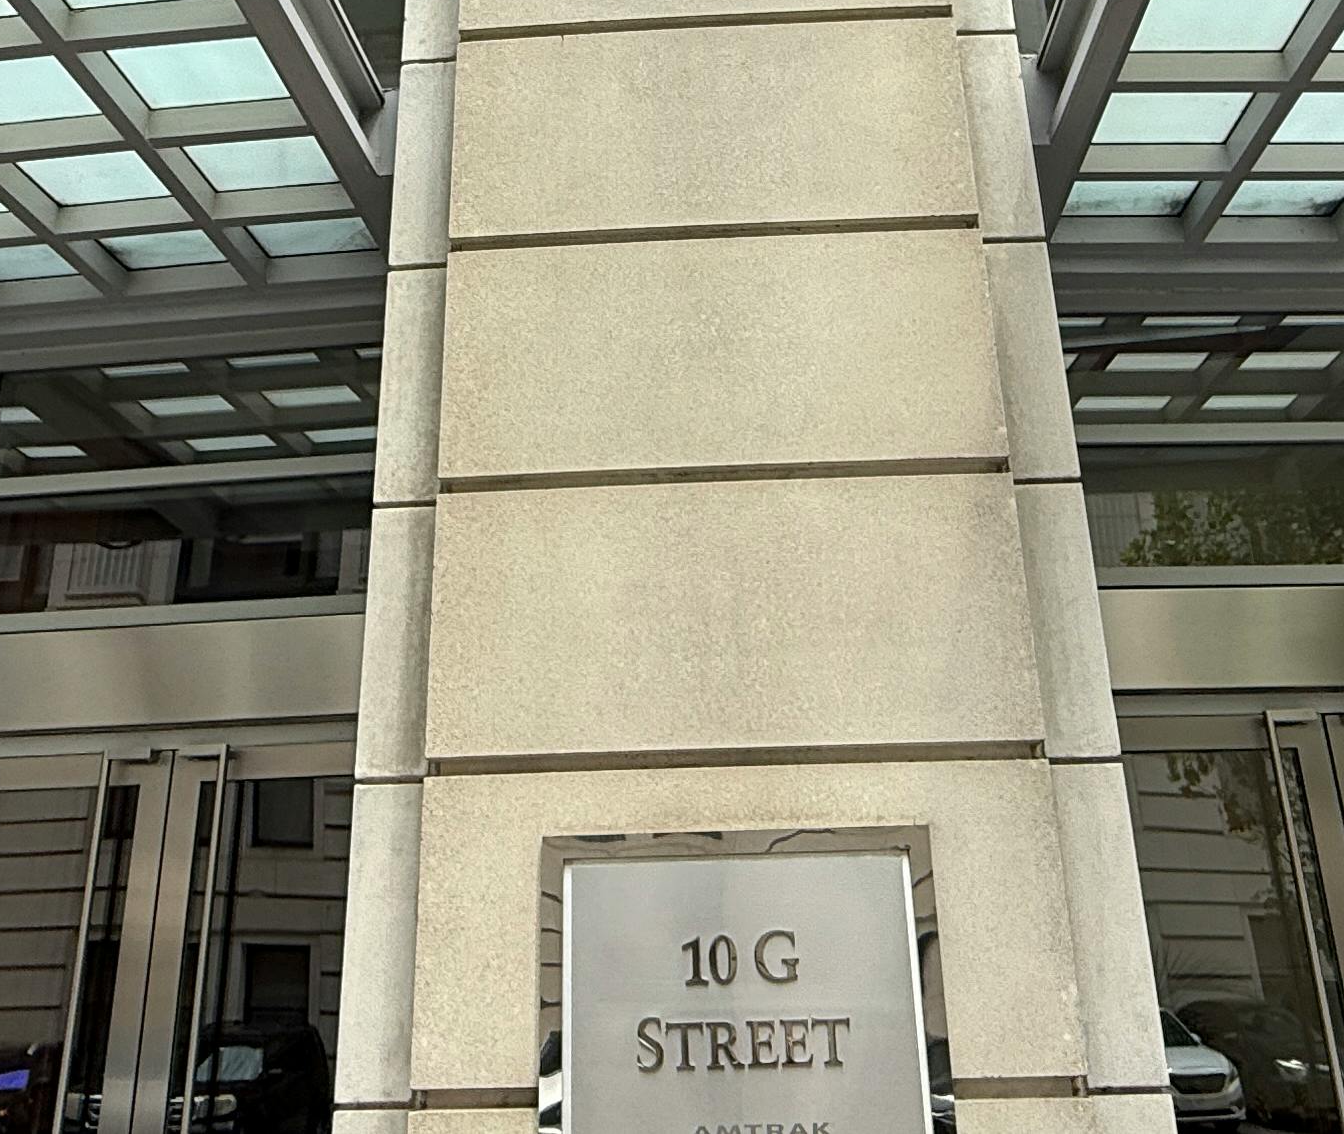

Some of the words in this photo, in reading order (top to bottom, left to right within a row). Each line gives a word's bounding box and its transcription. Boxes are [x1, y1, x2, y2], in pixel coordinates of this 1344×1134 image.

[681, 934, 738, 987] 10
[754, 930, 800, 983] G
[636, 1017, 850, 1072] STREET
